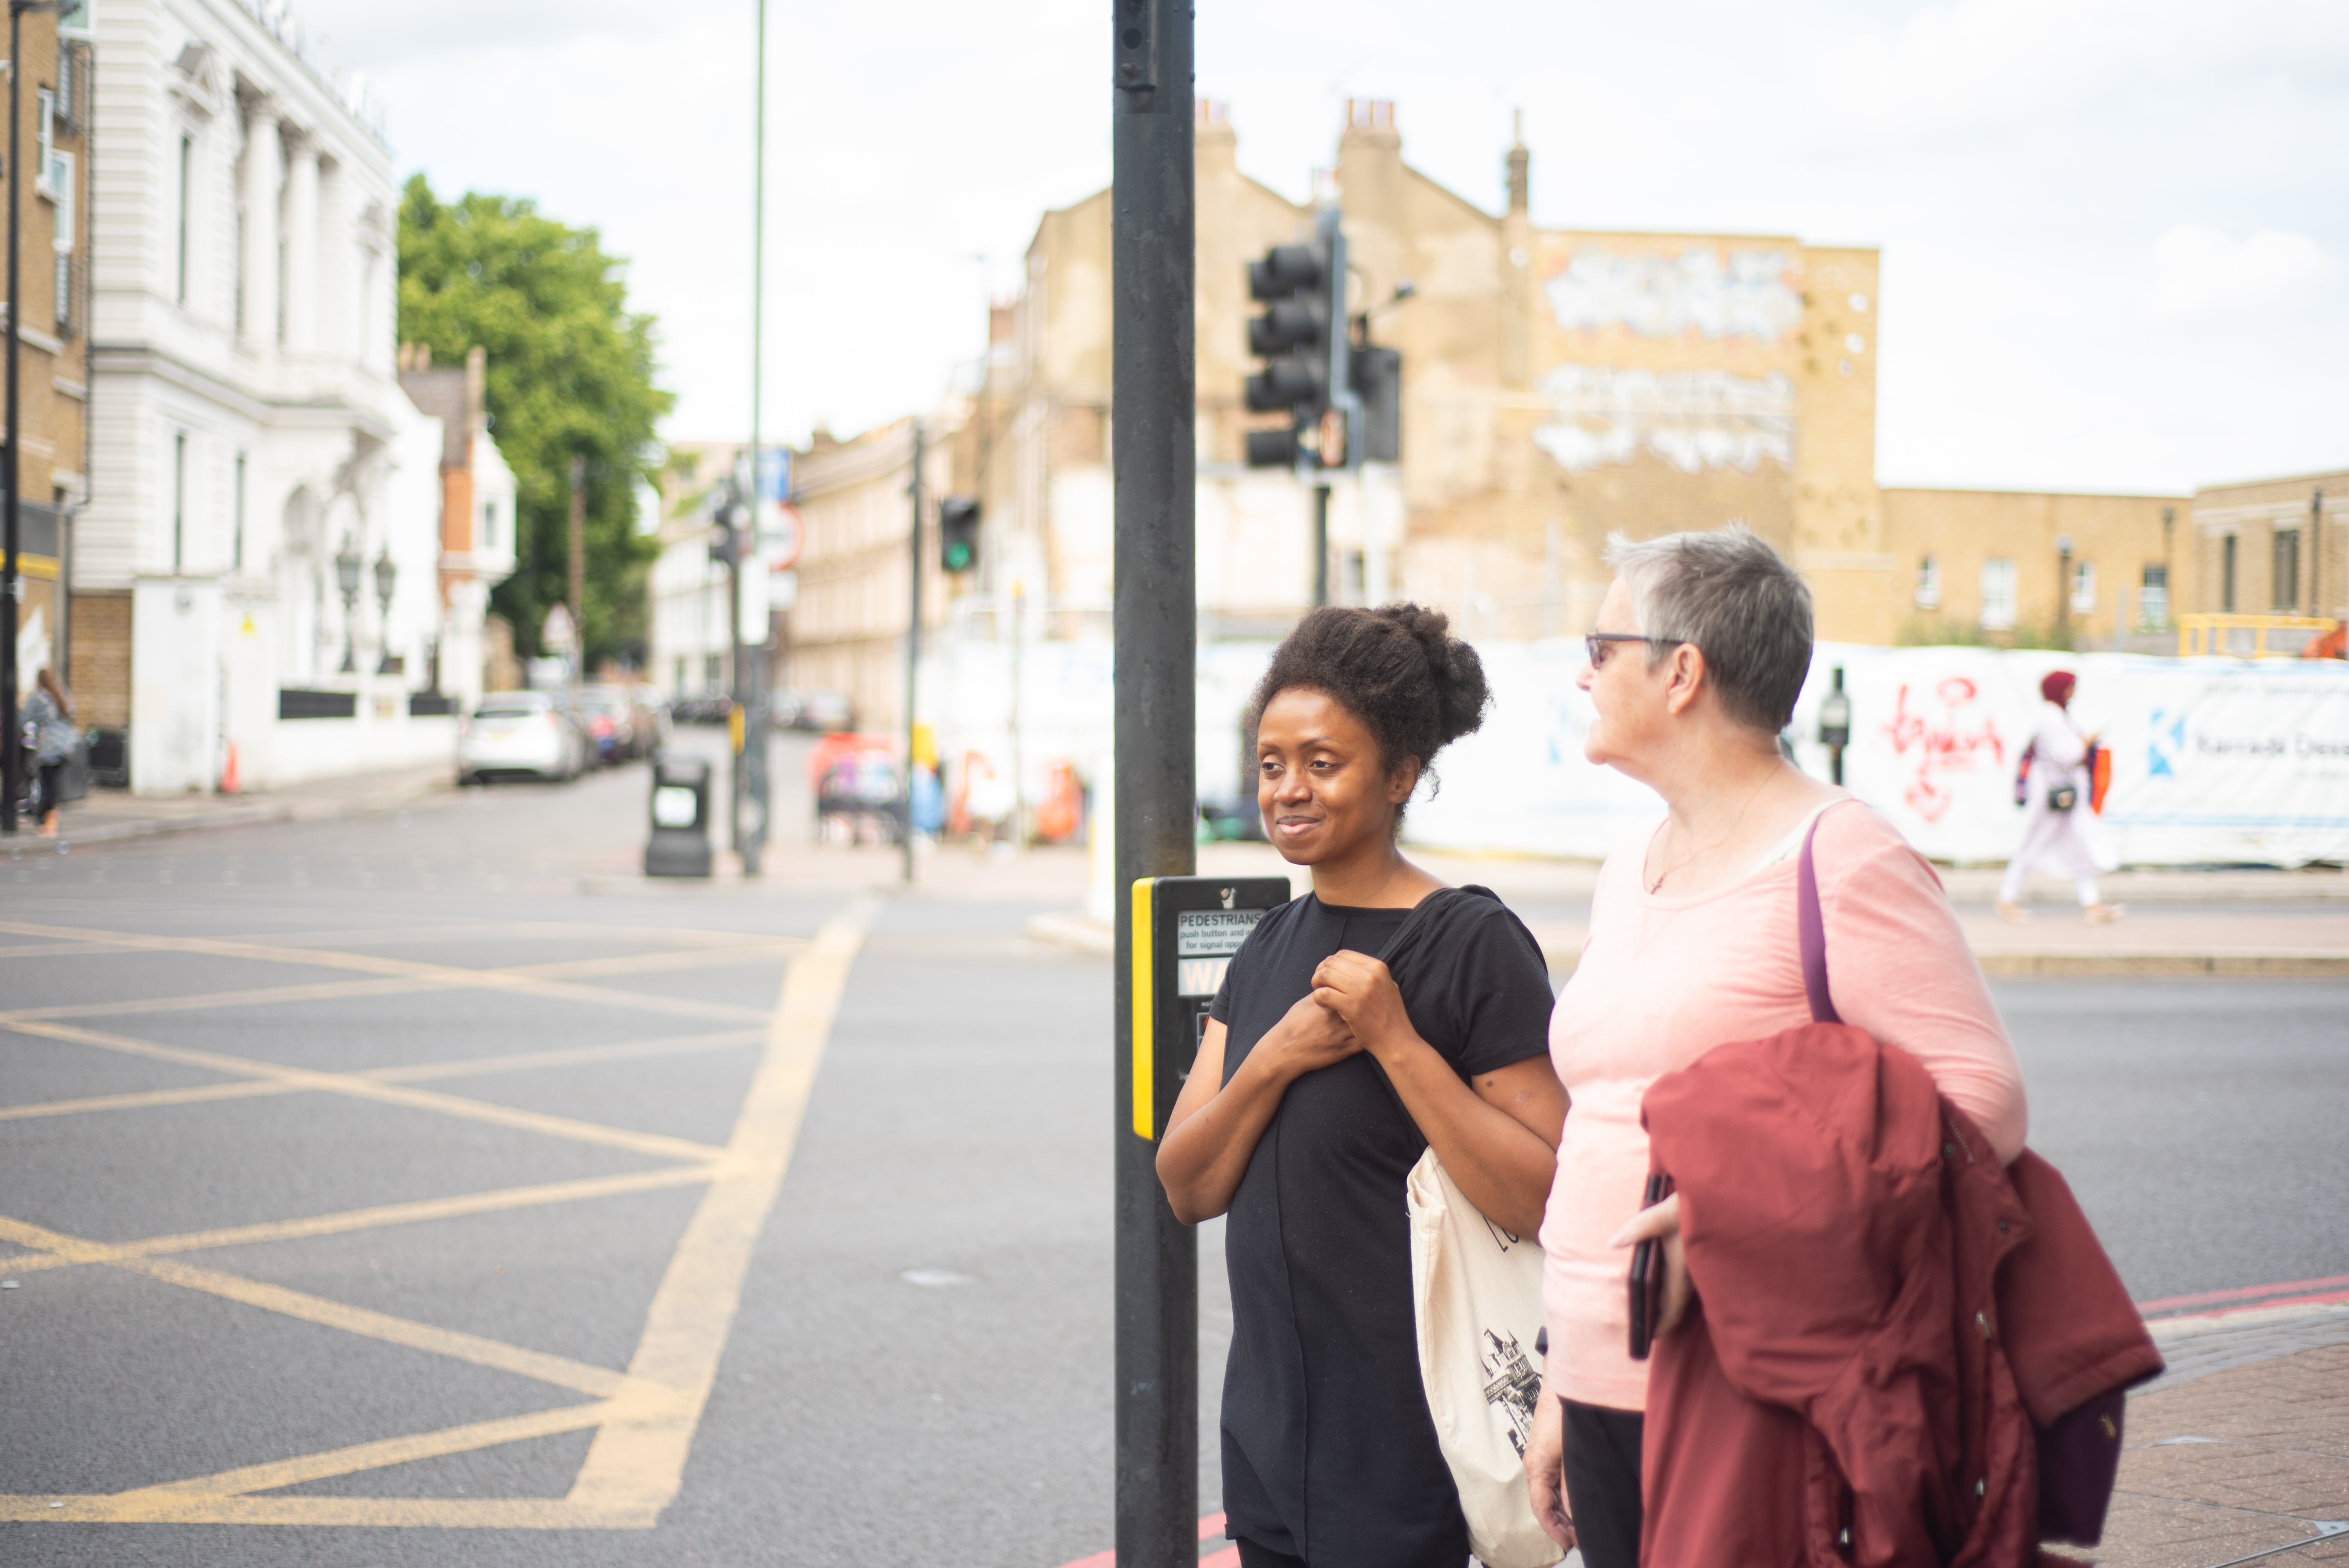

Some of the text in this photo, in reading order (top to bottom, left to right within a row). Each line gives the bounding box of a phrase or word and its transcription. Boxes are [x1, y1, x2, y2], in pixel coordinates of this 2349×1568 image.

[1180, 913, 1261, 927] PEDESTRIANS
[1180, 929, 1199, 939] push
[1201, 928, 1227, 937] button
[1230, 928, 1244, 936] and
[1186, 941, 1197, 949] for
[1200, 940, 1223, 950] signal
